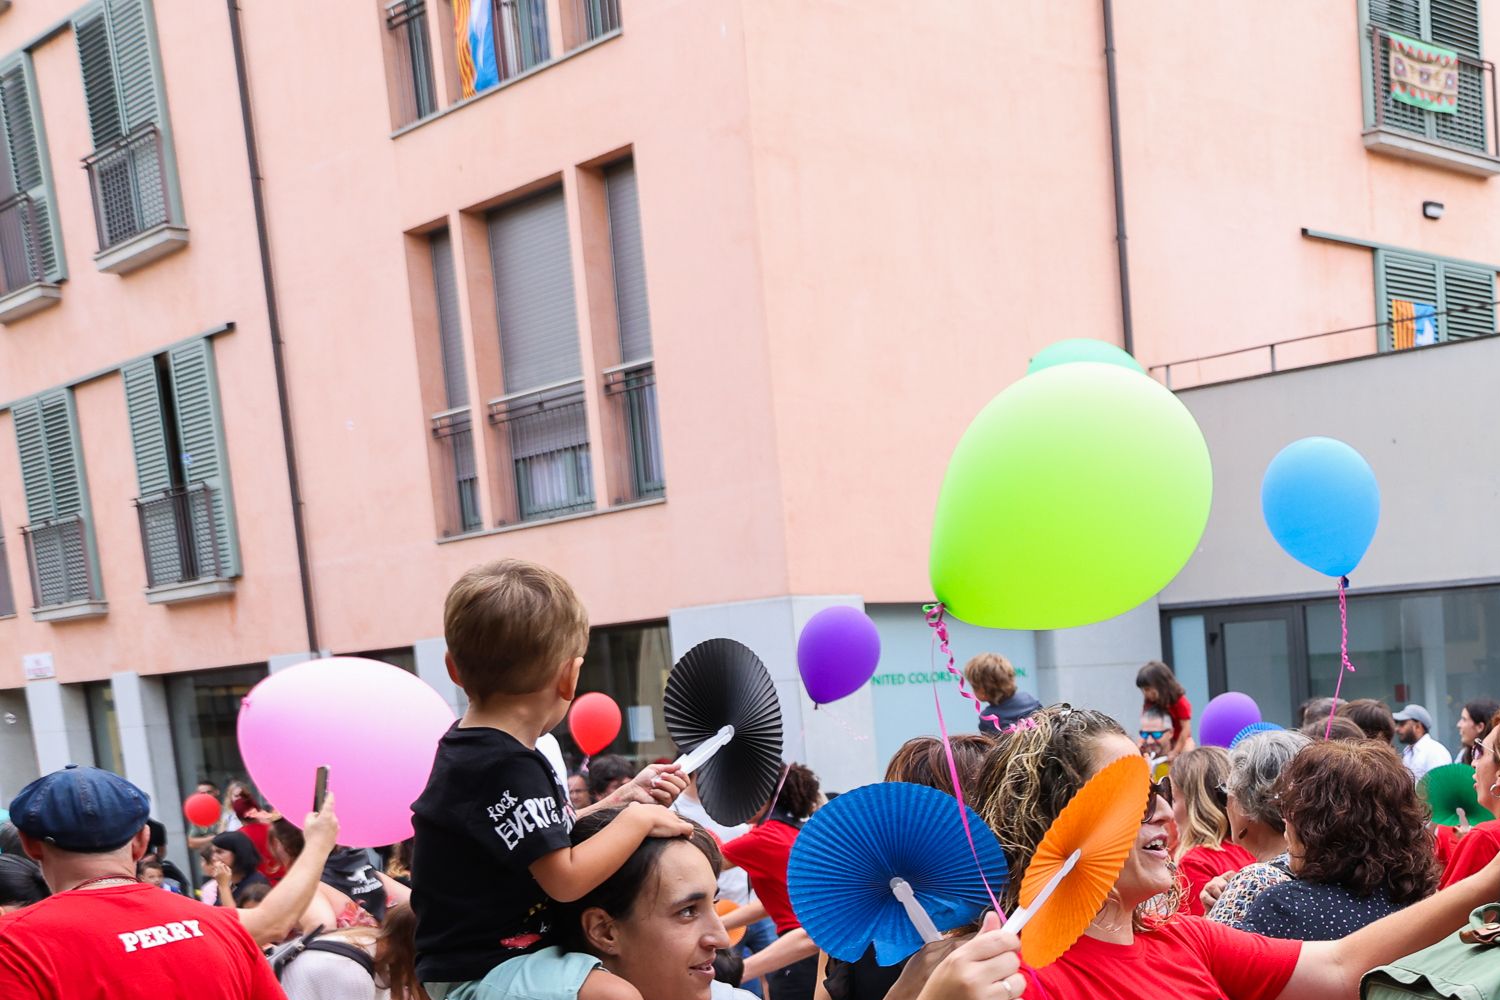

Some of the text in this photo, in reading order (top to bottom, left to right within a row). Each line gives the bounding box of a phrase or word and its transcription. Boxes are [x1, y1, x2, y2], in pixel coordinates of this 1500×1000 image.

[871, 672, 906, 686] NITED
[908, 669, 952, 684] COLORS
[487, 789, 518, 822] ROCK
[118, 919, 204, 953] PERRY
